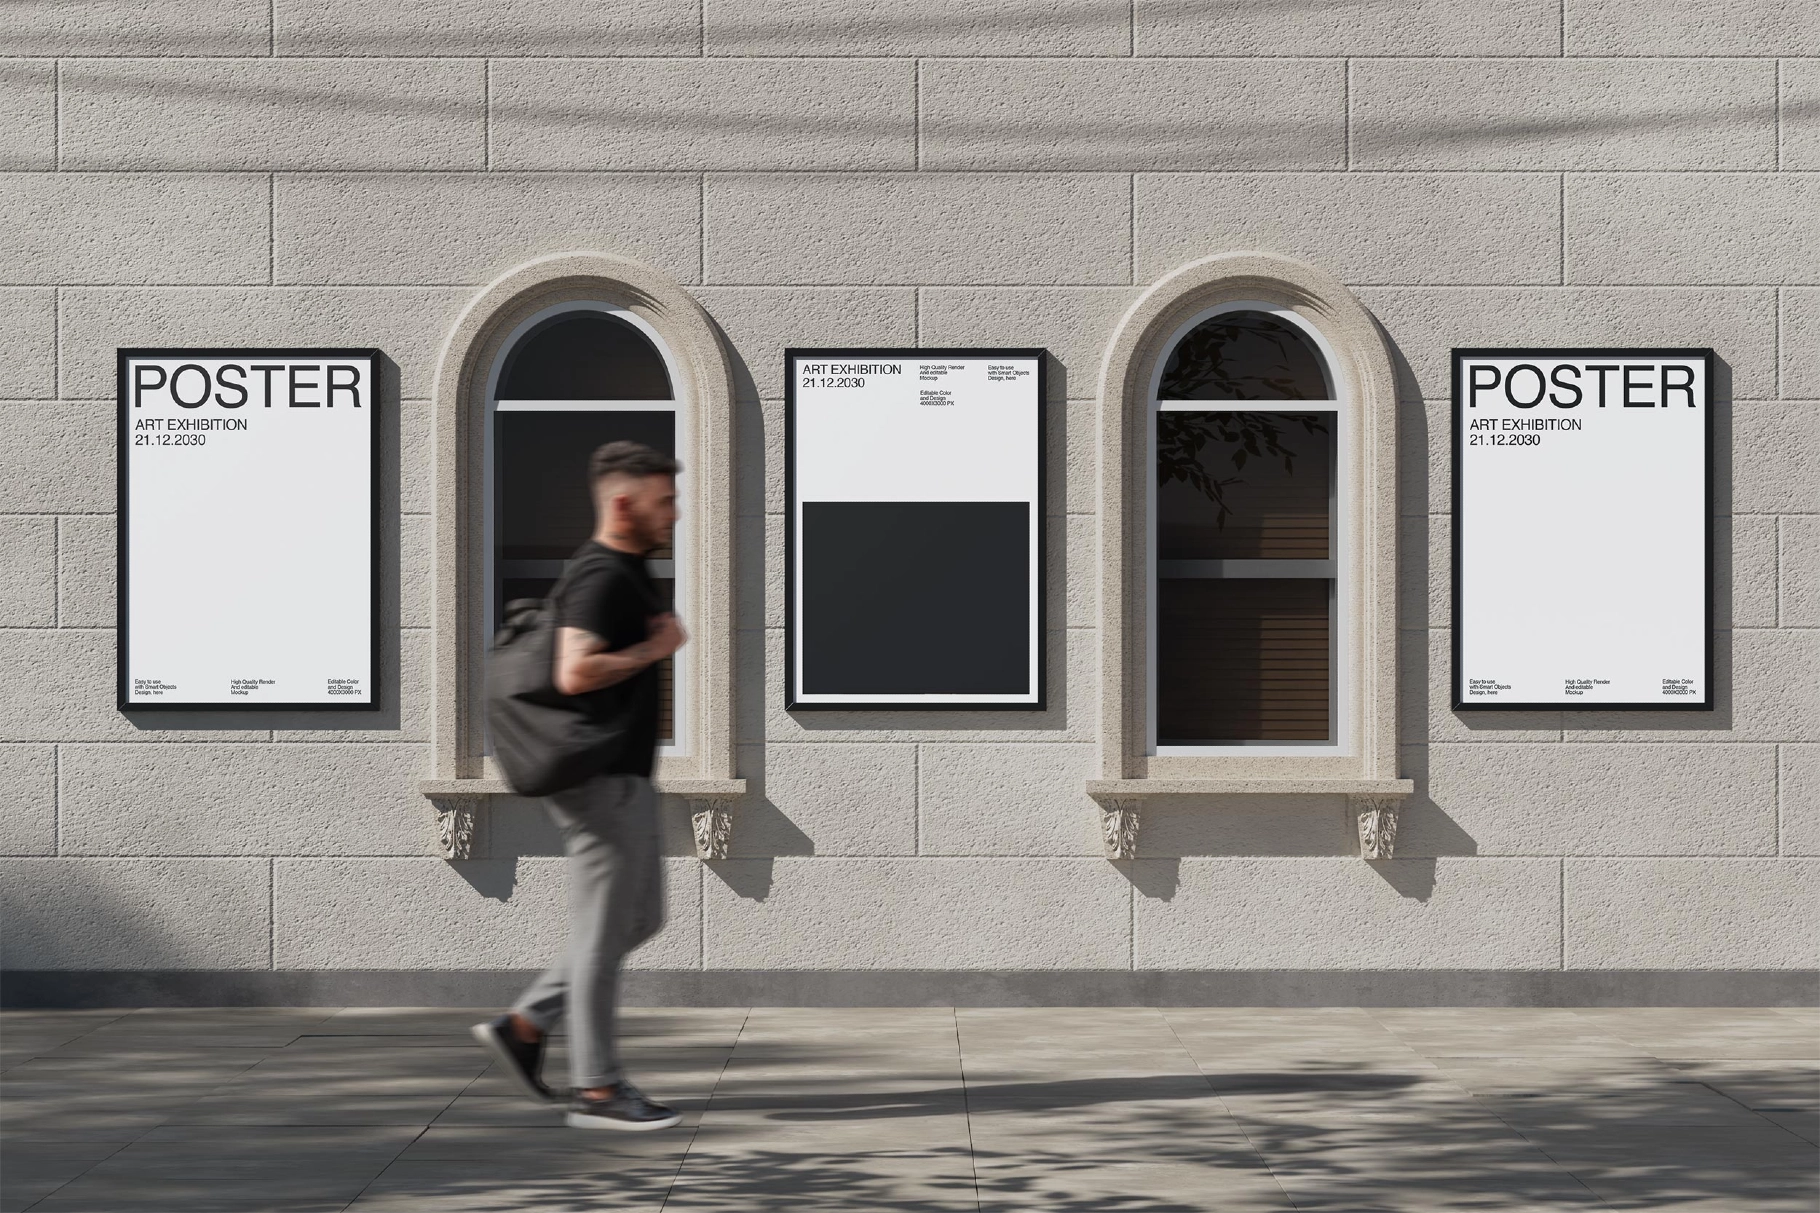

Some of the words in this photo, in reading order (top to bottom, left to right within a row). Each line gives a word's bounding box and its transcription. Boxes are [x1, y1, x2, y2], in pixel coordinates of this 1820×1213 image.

[803, 364, 828, 374] ART
[831, 364, 902, 374] EXHIBITION
[135, 364, 362, 408] POSTER
[803, 378, 865, 388] 21.12.2030
[1470, 364, 1696, 408] POSTER
[136, 419, 164, 430] ART
[168, 419, 247, 430] EXHIBITION
[1470, 419, 1498, 430] ART
[1502, 419, 1582, 430] EXHIBITION
[136, 434, 206, 446] 21.12.2030
[1470, 434, 1540, 446] 21.12.2030
